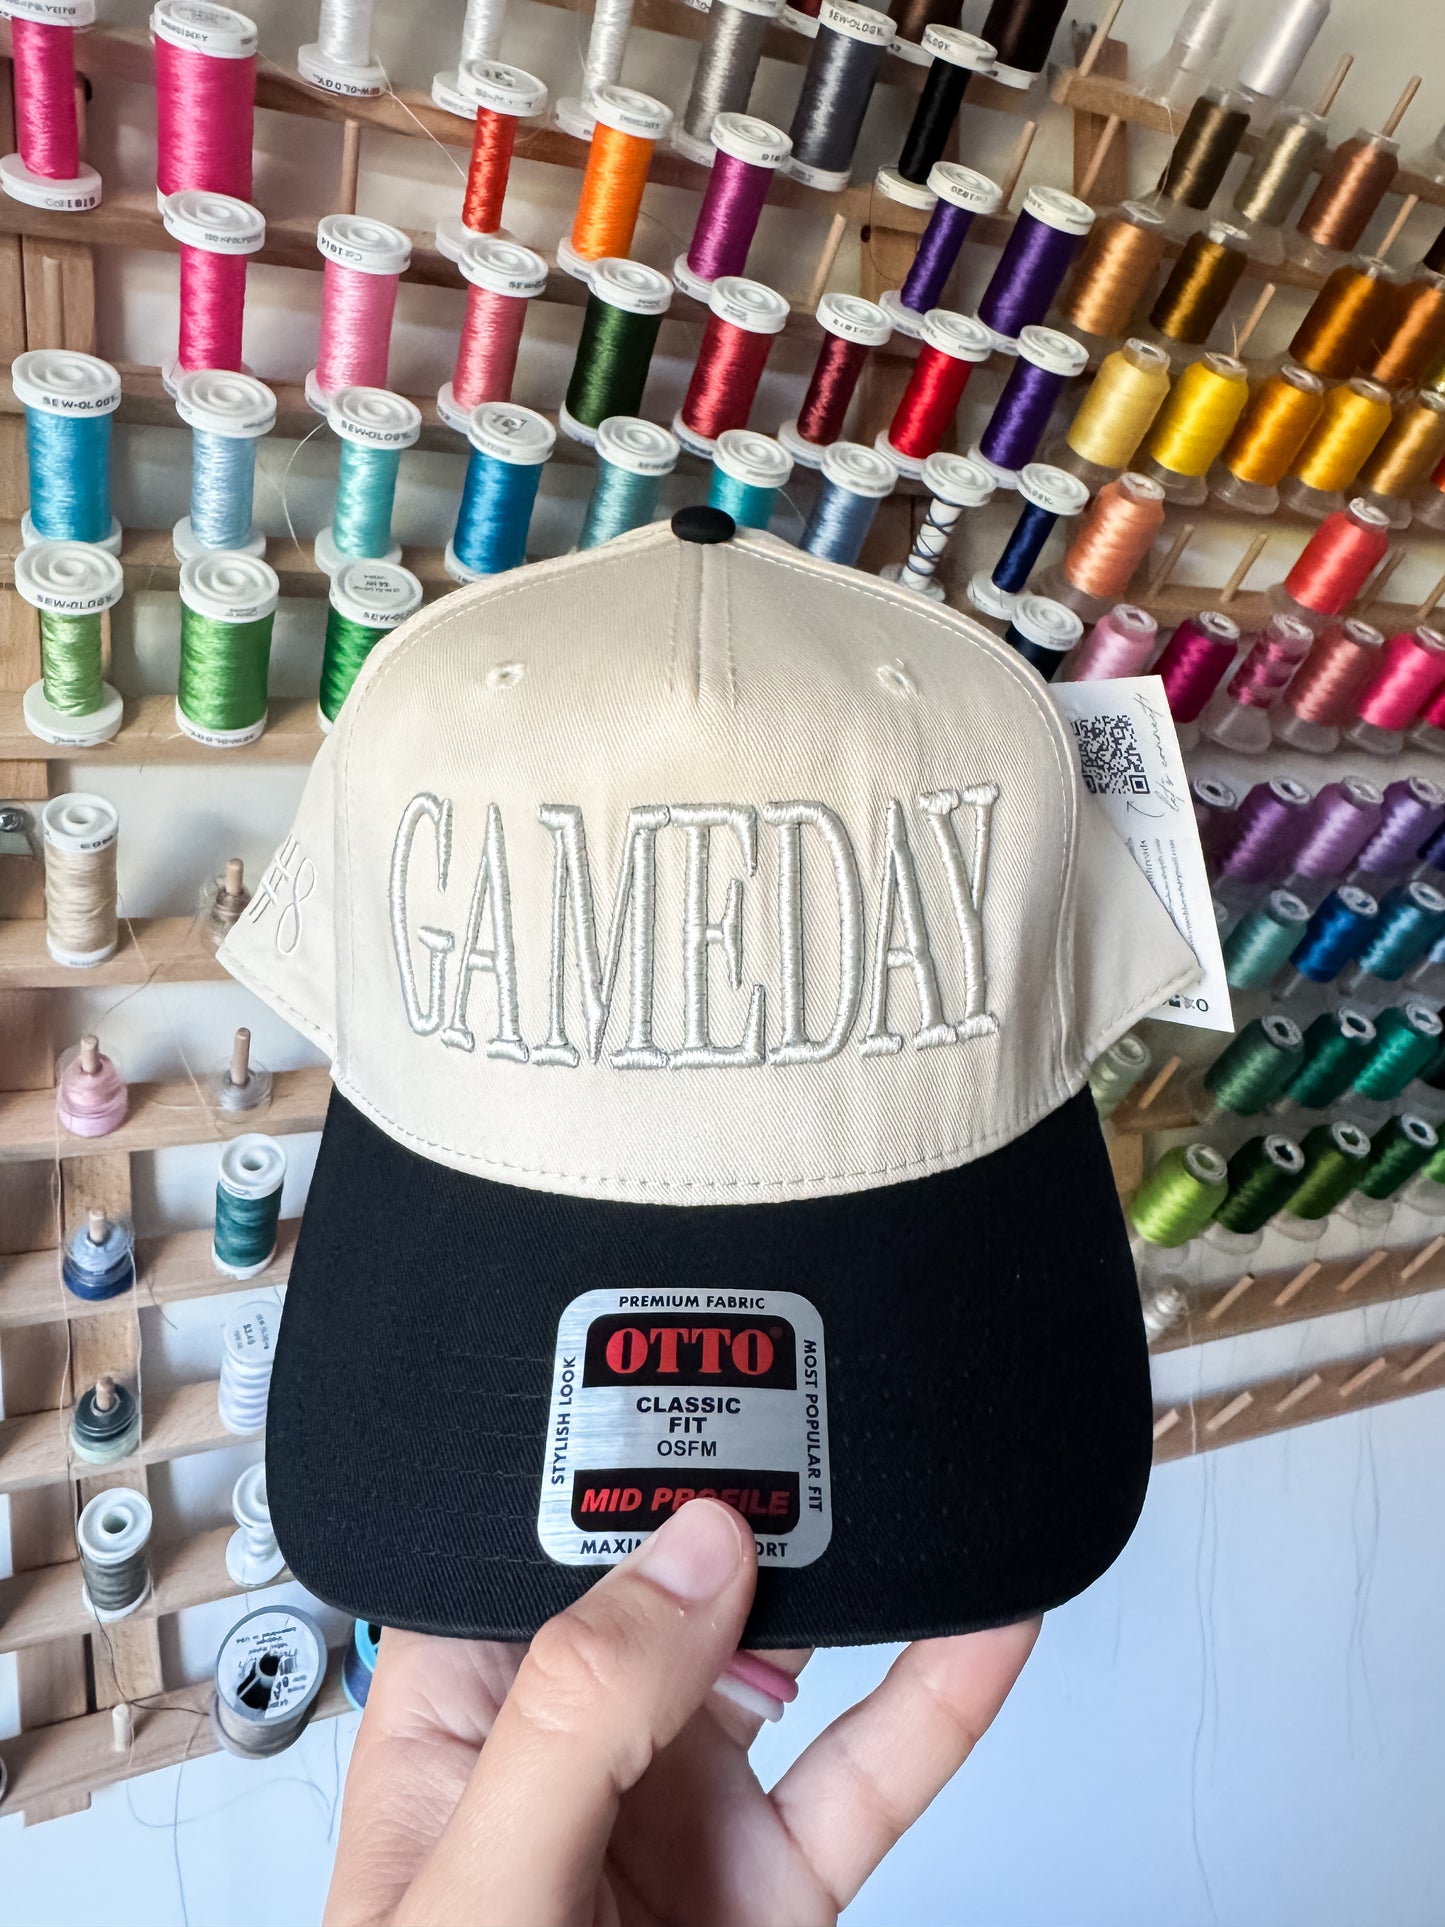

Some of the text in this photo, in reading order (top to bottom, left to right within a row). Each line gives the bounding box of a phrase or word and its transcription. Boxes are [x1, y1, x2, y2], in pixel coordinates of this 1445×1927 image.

[388, 781, 1000, 1070] GAMEDAY
[618, 1295, 766, 1310] PREMIUM FABRIC
[605, 1327, 775, 1376] OTTO
[636, 1396, 741, 1414] CLASSIC
[551, 1355, 577, 1485] STYLISH LOOK
[668, 1417, 708, 1434] FIT
[803, 1339, 823, 1513] MOST POPULAR FIT
[656, 1440, 717, 1457] OSFM
[580, 1487, 791, 1516] MID PRFILE
[579, 1538, 643, 1555] MAXI
